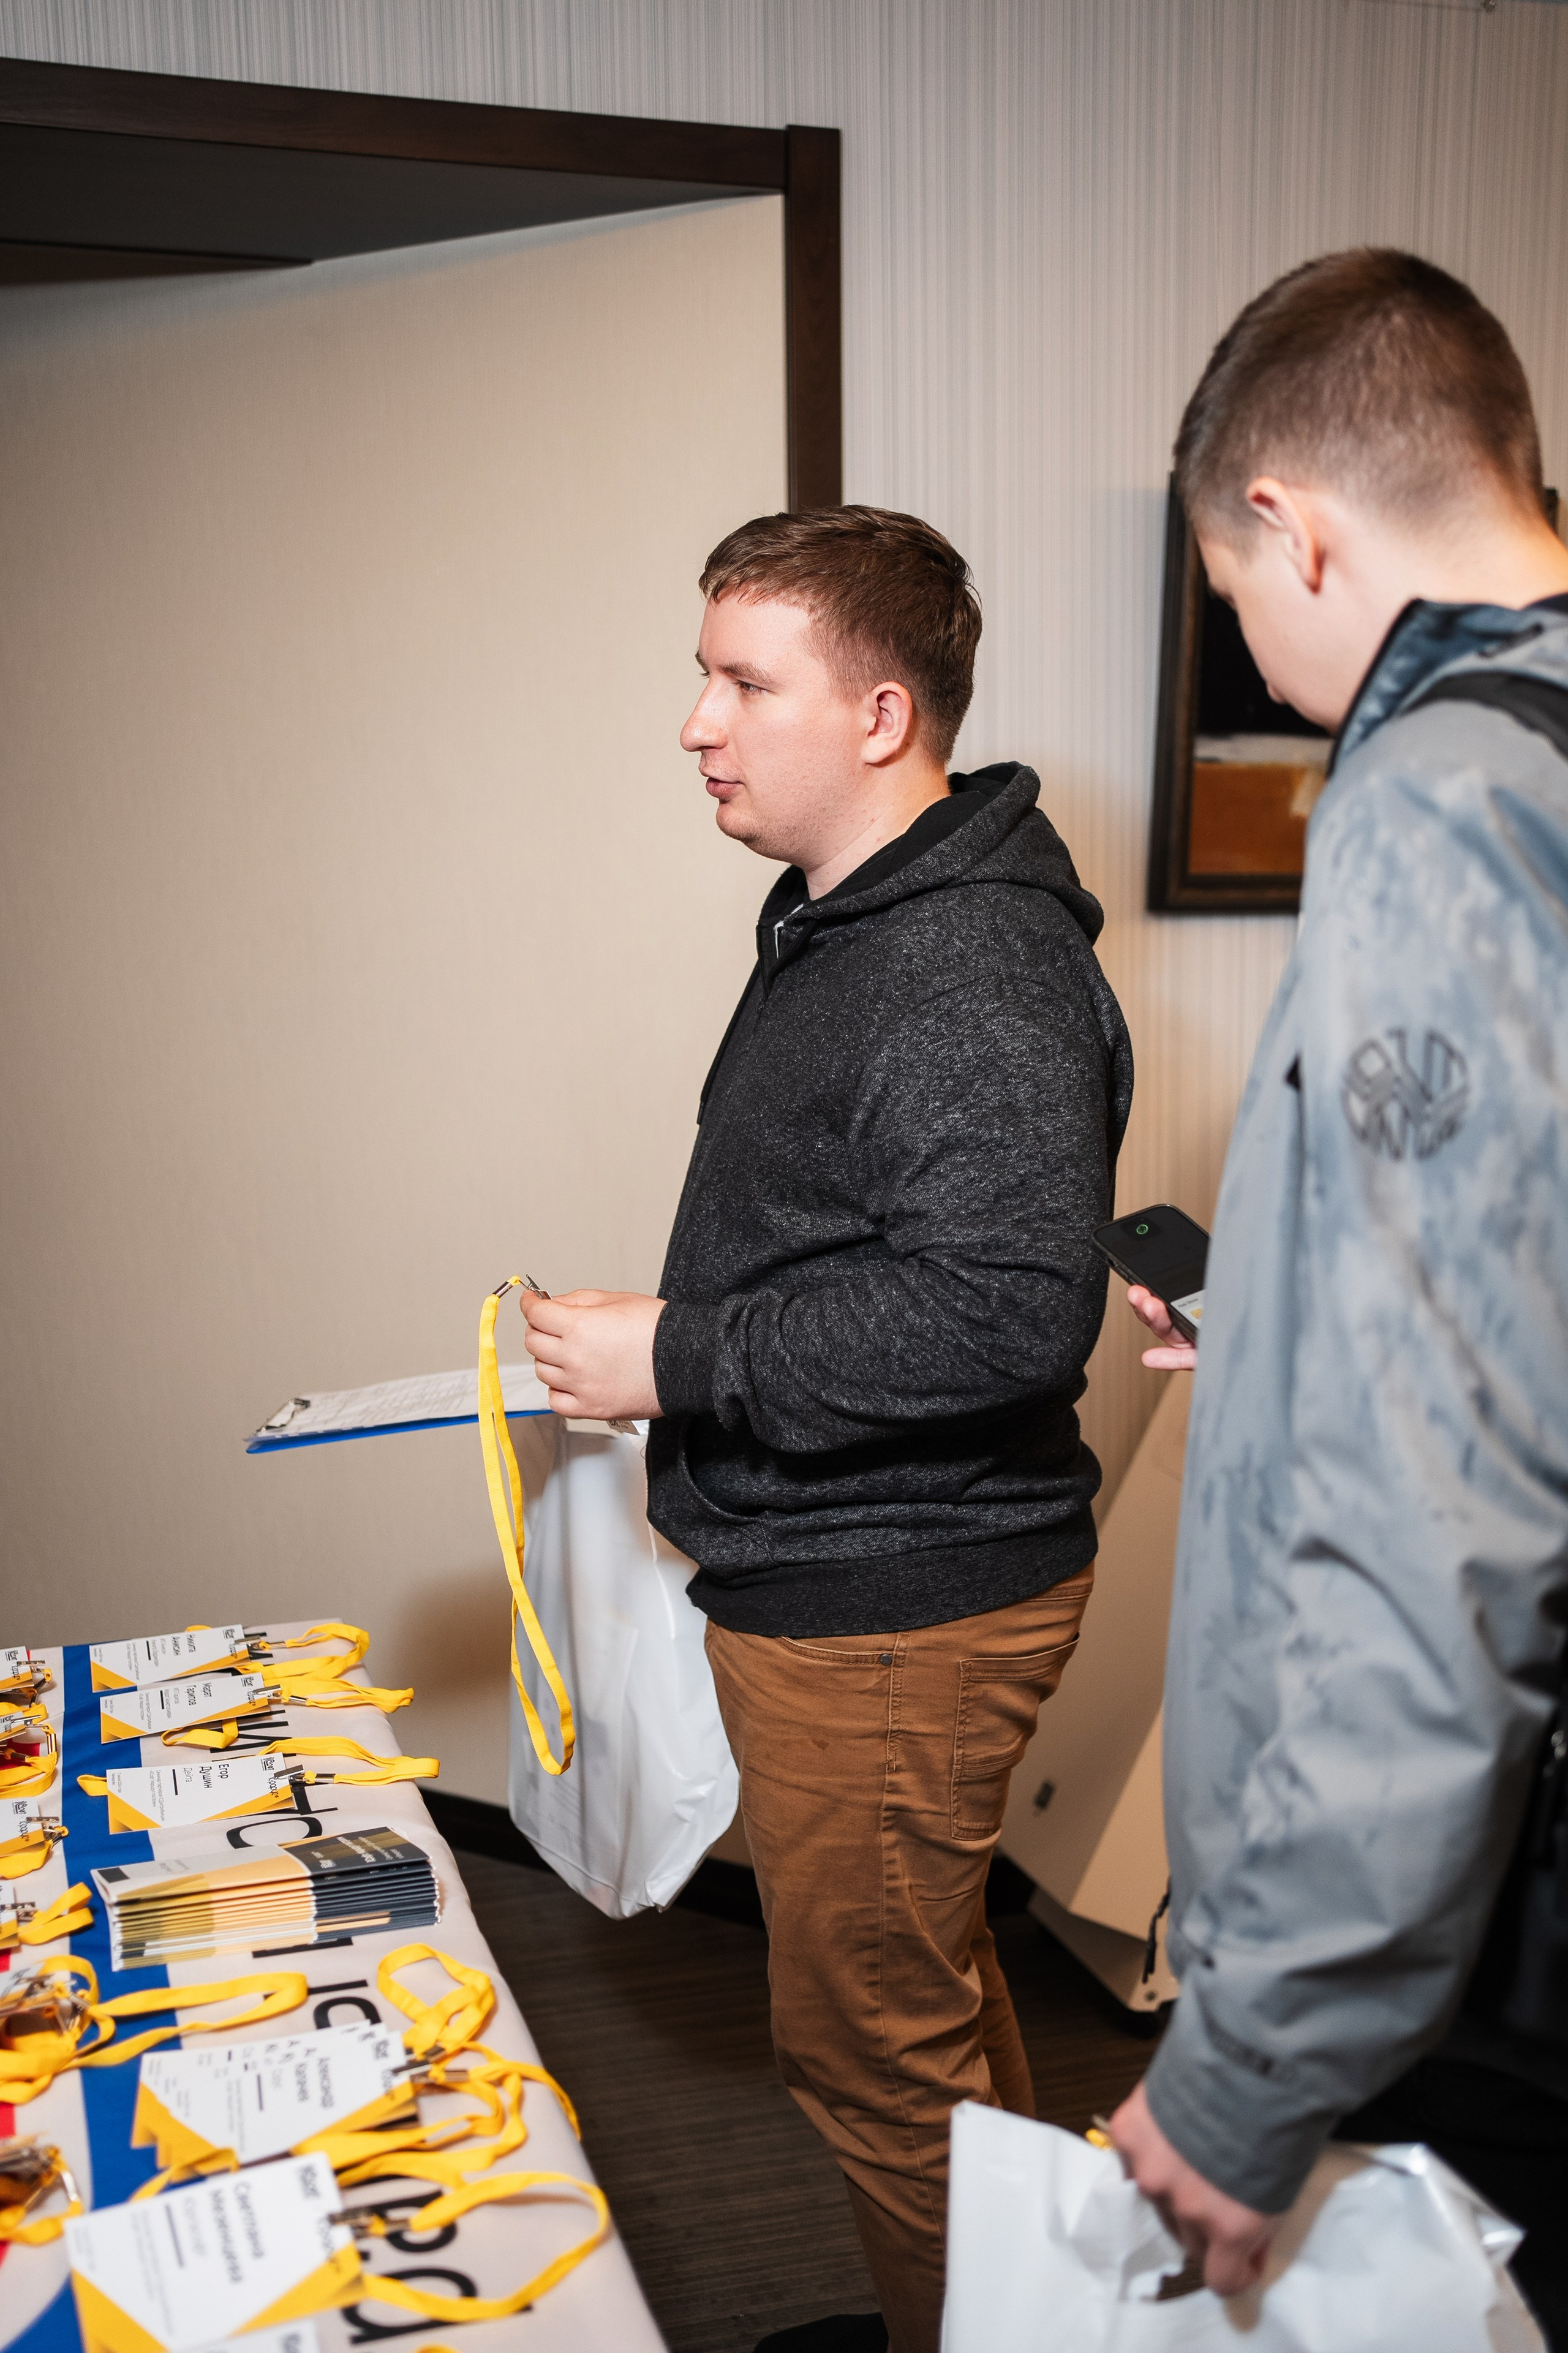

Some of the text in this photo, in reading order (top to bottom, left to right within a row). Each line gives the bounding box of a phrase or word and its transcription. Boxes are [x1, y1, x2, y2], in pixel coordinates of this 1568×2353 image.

[186, 1634, 196, 1653] Никита
[187, 1685, 197, 1706] Гарипов
[202, 1682, 212, 1698] Марат
[183, 1767, 193, 1783] Дейта
[199, 1766, 213, 1789] Душин
[217, 1764, 230, 1779] Егор
[318, 2057, 334, 2109] Александр
[234, 2181, 264, 2259] Светлана
